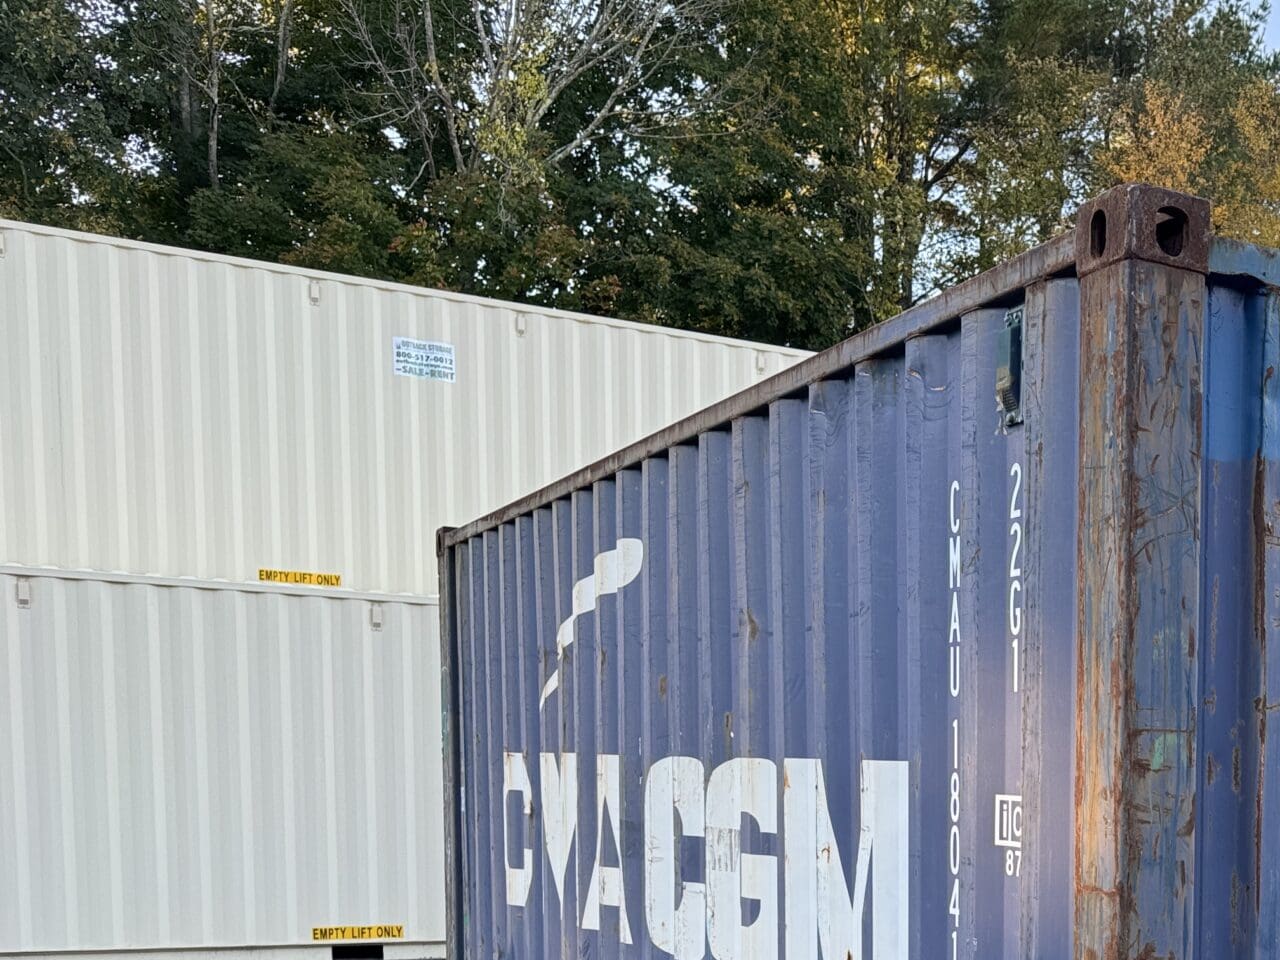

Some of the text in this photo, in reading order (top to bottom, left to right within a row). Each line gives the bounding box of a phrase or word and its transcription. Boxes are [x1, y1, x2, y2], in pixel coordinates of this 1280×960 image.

[258, 569, 341, 586] EMPTY LIFT ONLY
[949, 480, 961, 697] CMAU
[1009, 462, 1022, 693] 22G1
[312, 926, 403, 940] EMPTY LIFT ONLY
